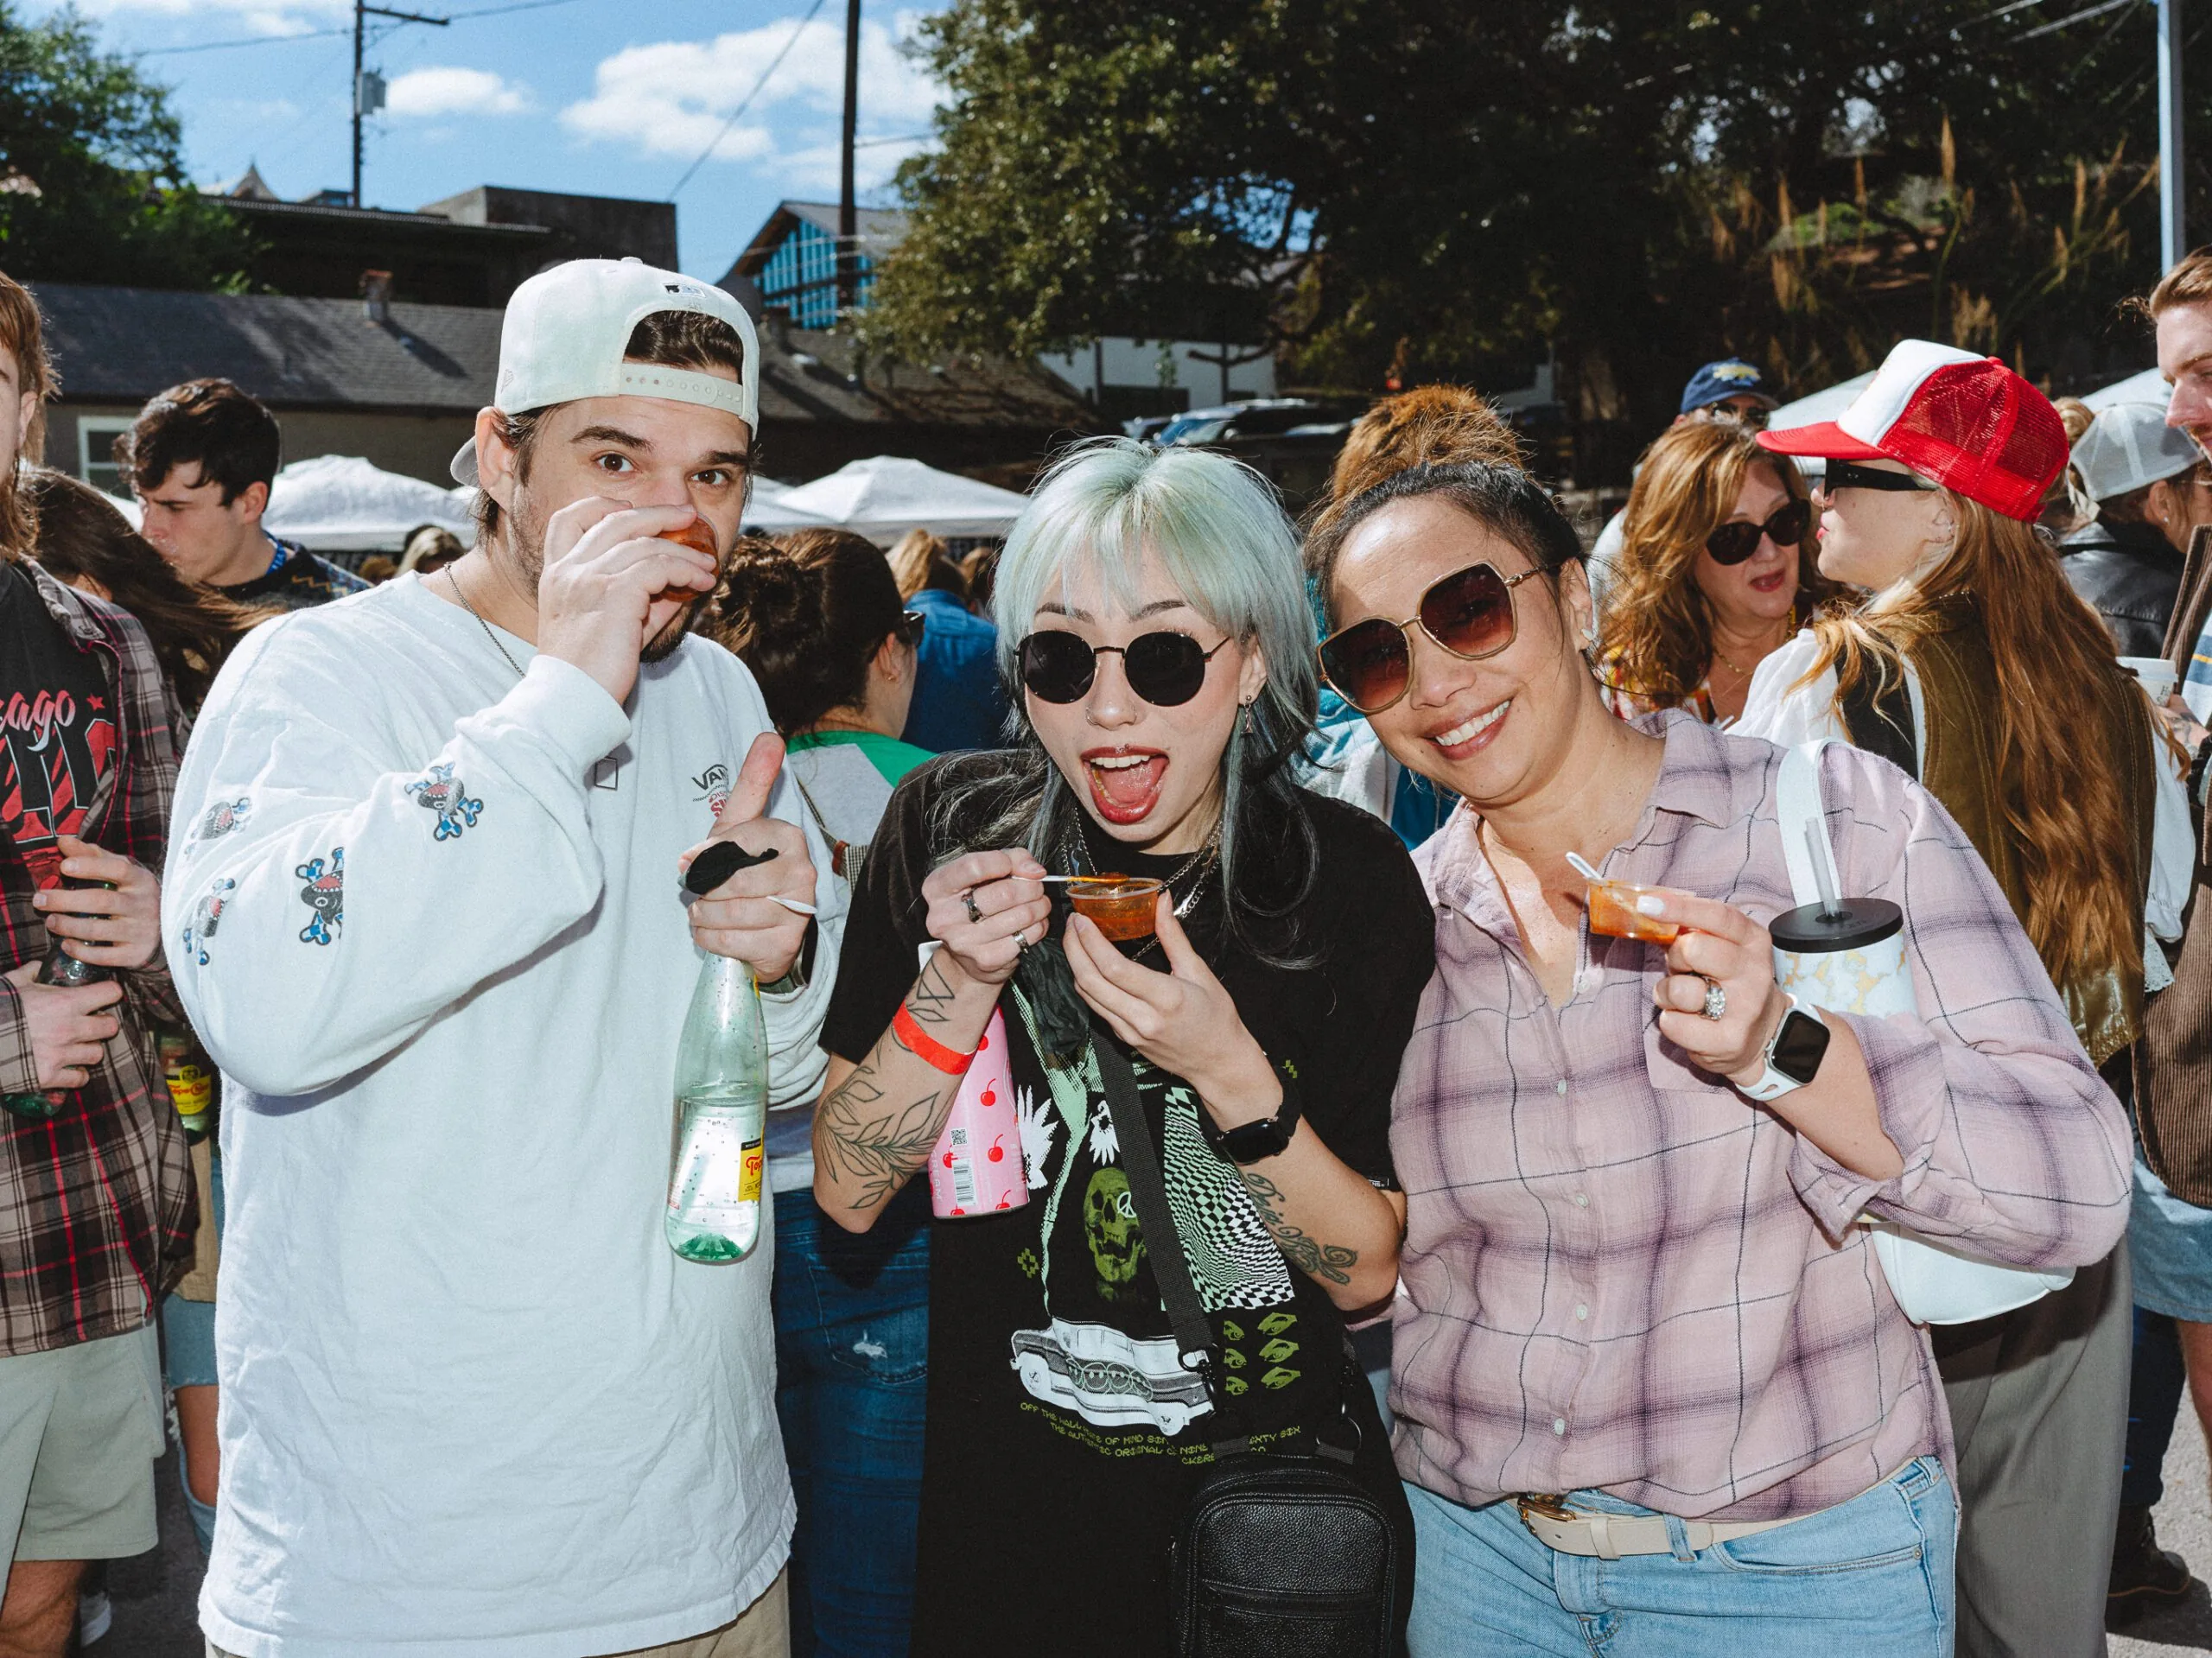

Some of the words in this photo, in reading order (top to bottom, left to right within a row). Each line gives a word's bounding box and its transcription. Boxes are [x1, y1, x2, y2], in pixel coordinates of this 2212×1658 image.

[1020, 1401, 1039, 1413] OFF
[1041, 1408, 1058, 1421] THE
[1104, 1437, 1121, 1445] OF
[1147, 1434, 1168, 1445] SIN
[1280, 1426, 1301, 1439] SIX
[1050, 1421, 1065, 1435] THE
